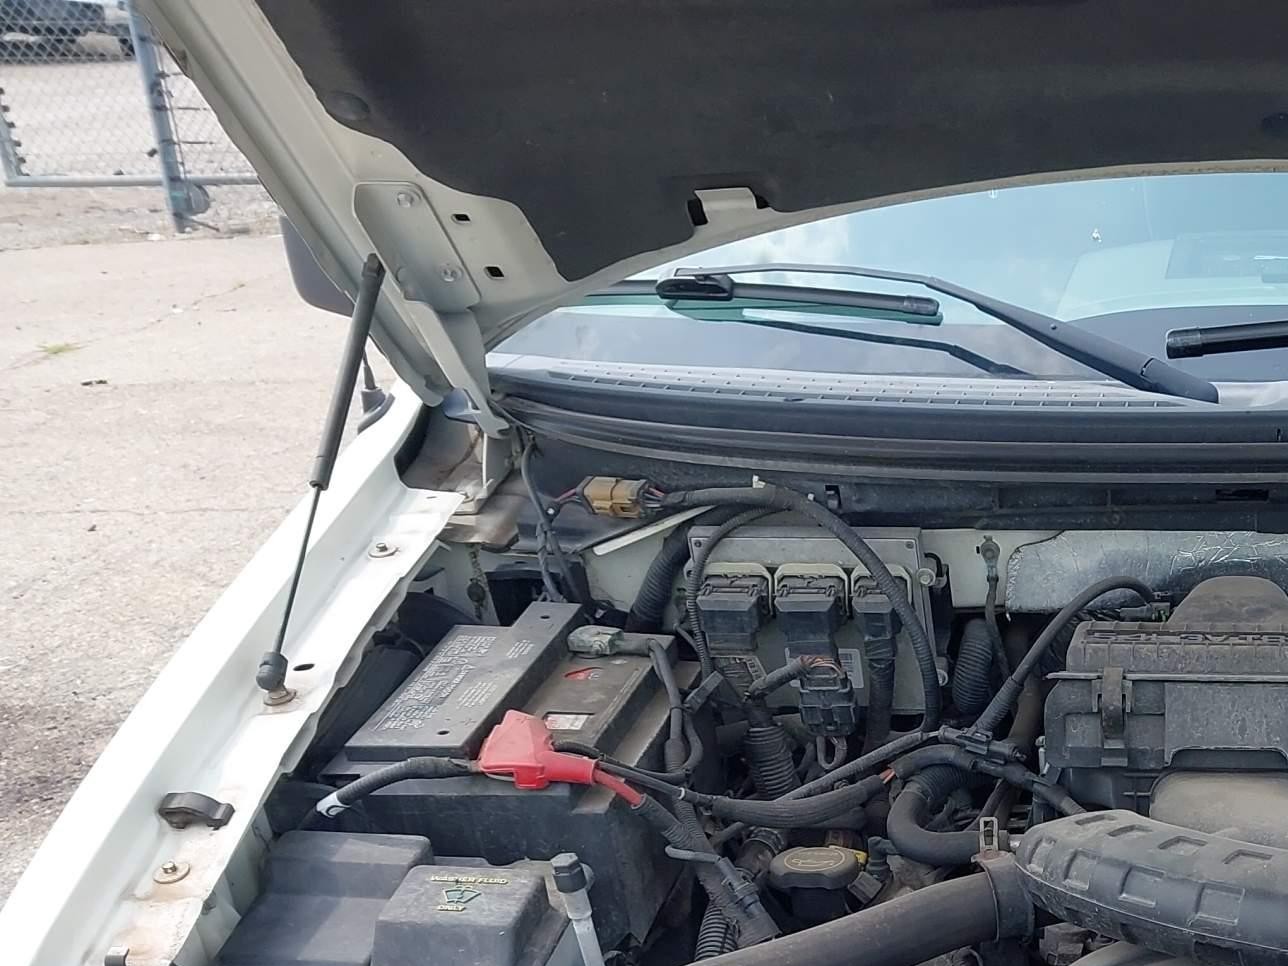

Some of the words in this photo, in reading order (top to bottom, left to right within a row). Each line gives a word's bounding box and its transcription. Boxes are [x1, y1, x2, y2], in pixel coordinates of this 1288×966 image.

[430, 875, 476, 884] WASHER
[477, 876, 509, 885] FLUID
[436, 904, 467, 912] ONLY
